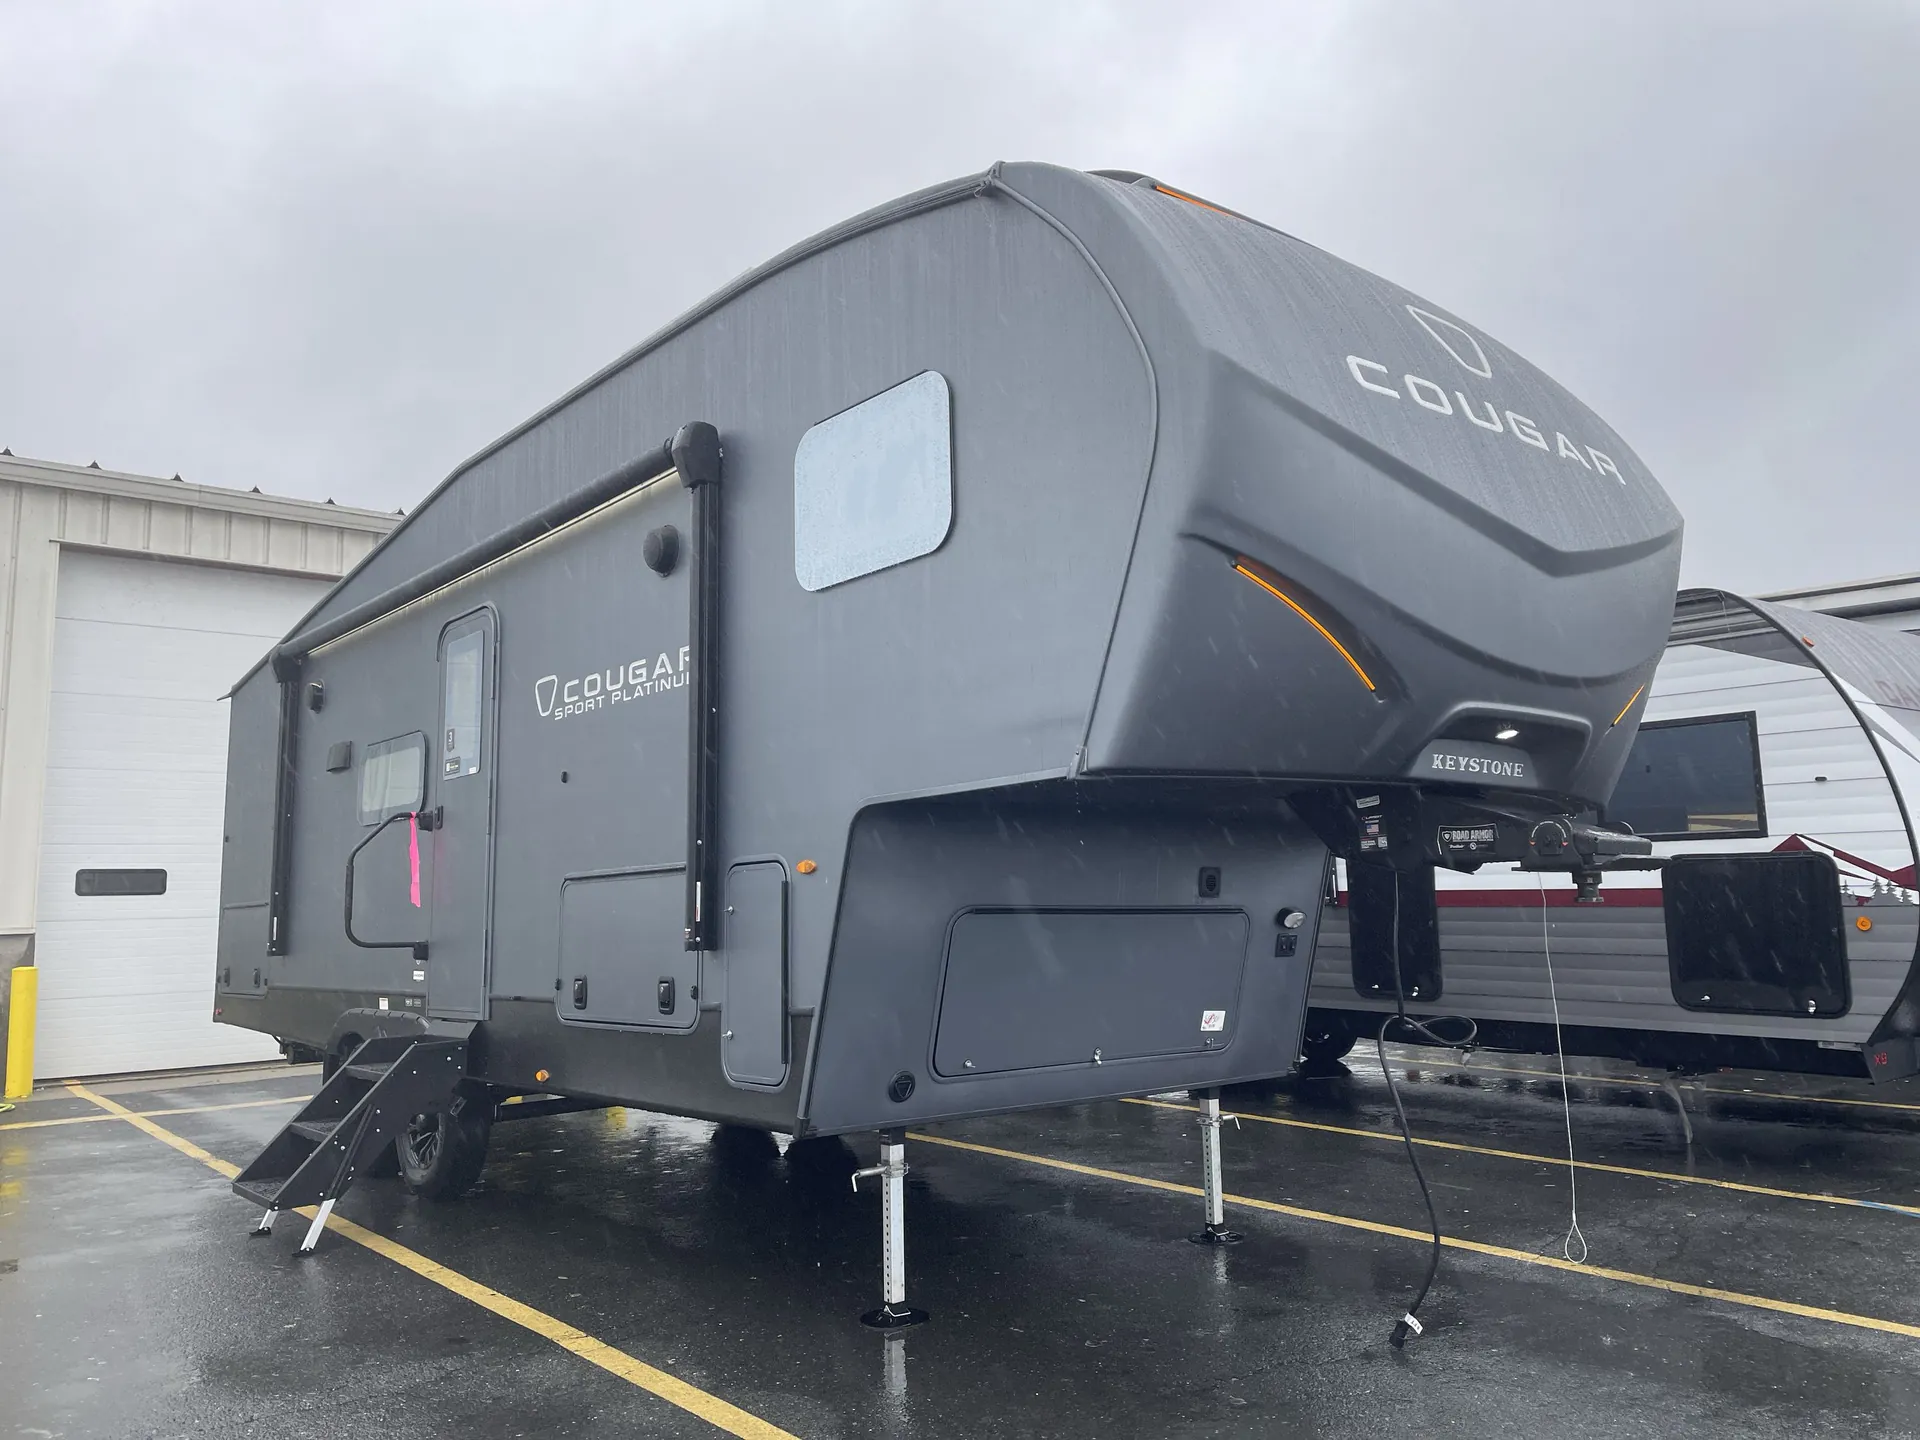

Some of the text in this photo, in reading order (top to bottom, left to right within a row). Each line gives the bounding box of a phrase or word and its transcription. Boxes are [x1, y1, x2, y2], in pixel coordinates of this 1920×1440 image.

[1346, 355, 1627, 485] COUGAR
[554, 672, 690, 720] SPORT PLATINU
[1432, 753, 1524, 777] KEYSTONE
